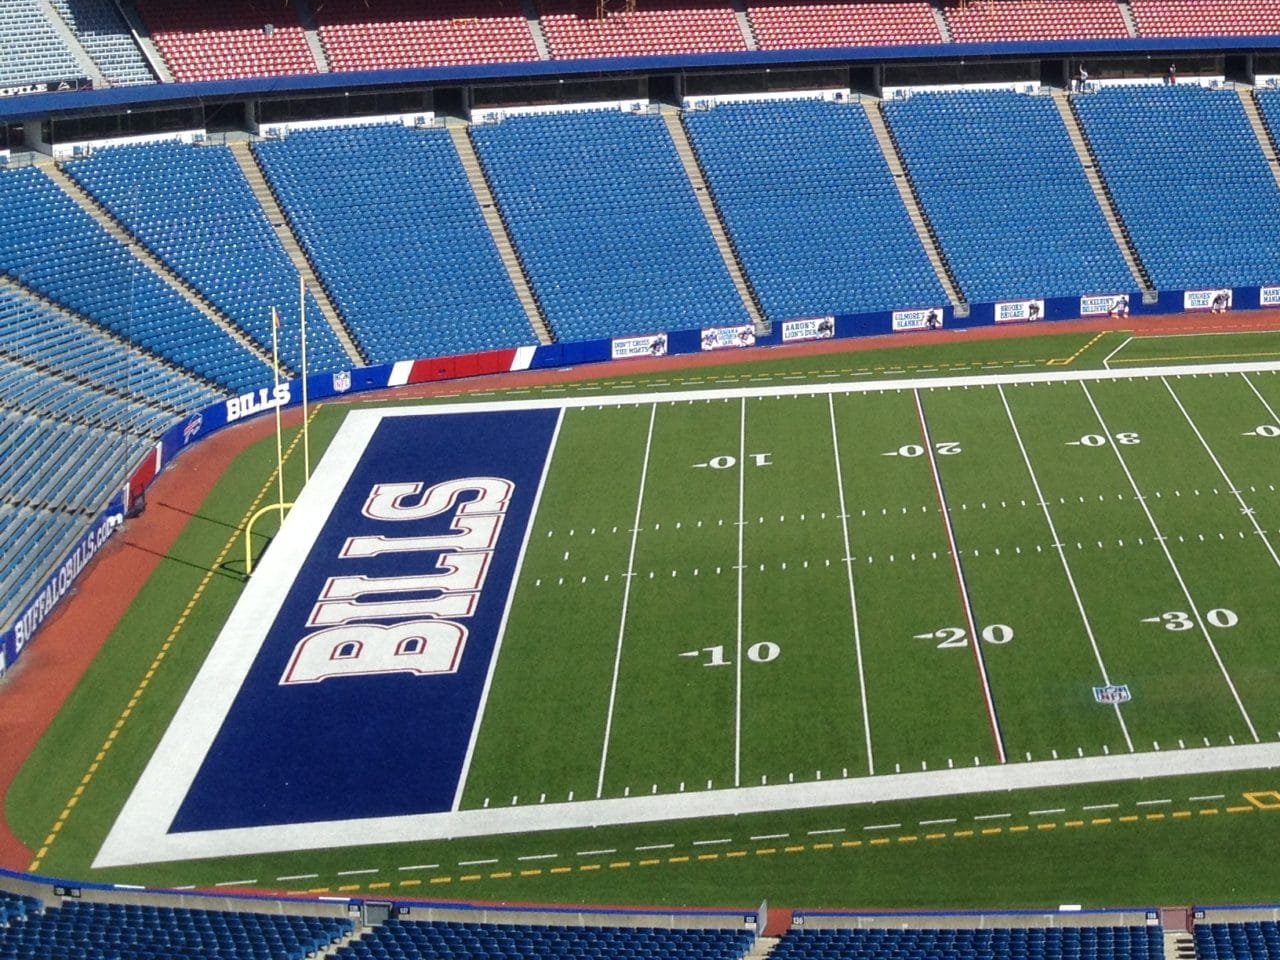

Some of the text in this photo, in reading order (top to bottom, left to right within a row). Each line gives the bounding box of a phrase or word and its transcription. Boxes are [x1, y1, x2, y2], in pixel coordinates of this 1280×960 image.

[785, 321, 816, 331] AARON'S
[614, 340, 631, 348] DON'T
[226, 382, 291, 422] BILLS
[897, 442, 963, 457] 20
[1080, 431, 1141, 447] 30
[708, 452, 773, 469] 10
[14, 513, 123, 653] BUFFALOBILLS.com
[278, 476, 516, 686] BILLS
[1161, 607, 1239, 631] 30
[935, 623, 1014, 649] 20
[703, 641, 781, 666] 10
